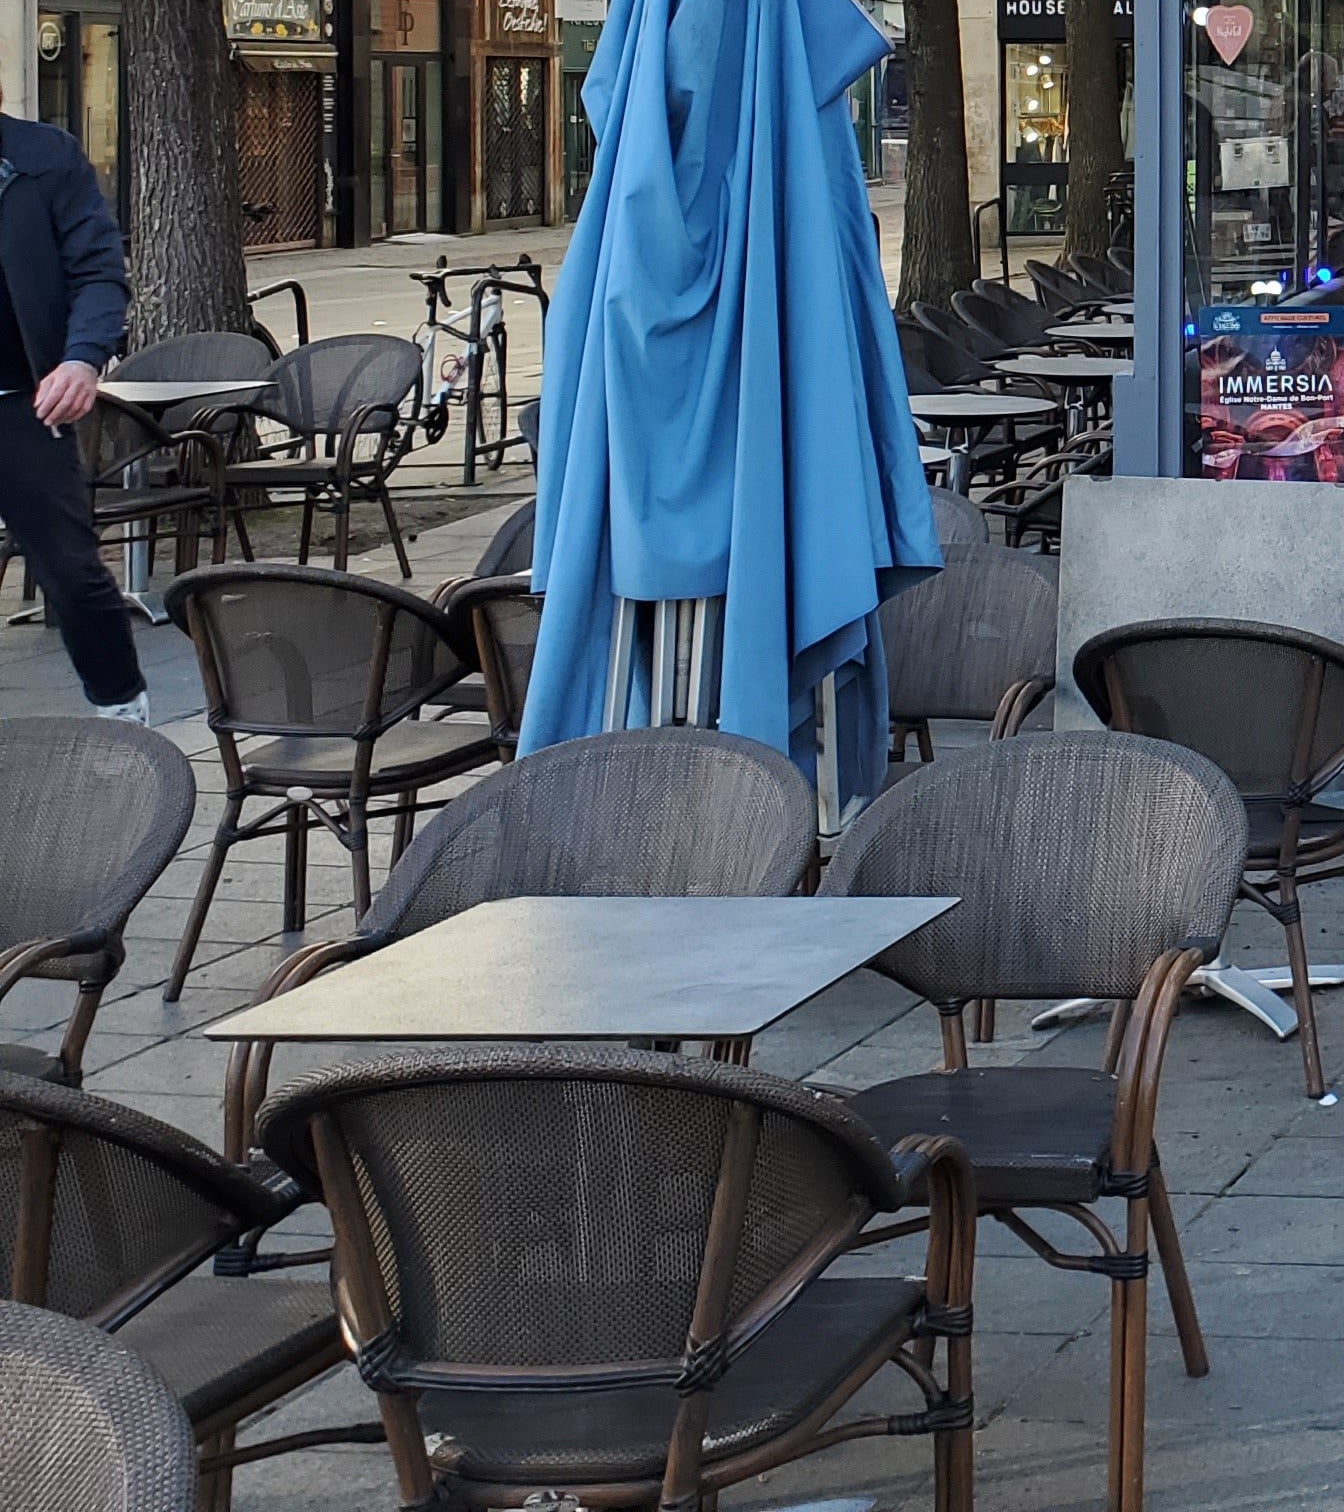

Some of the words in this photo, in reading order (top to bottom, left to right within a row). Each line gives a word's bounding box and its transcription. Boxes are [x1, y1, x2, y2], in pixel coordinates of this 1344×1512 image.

[1006, 0, 1067, 16] HOUSE
[1218, 373, 1334, 394] IMMERSIA
[1243, 395, 1288, 403] Notre-Dame
[1300, 394, 1334, 402] Bon-Port
[1260, 402, 1293, 410] NANTES
